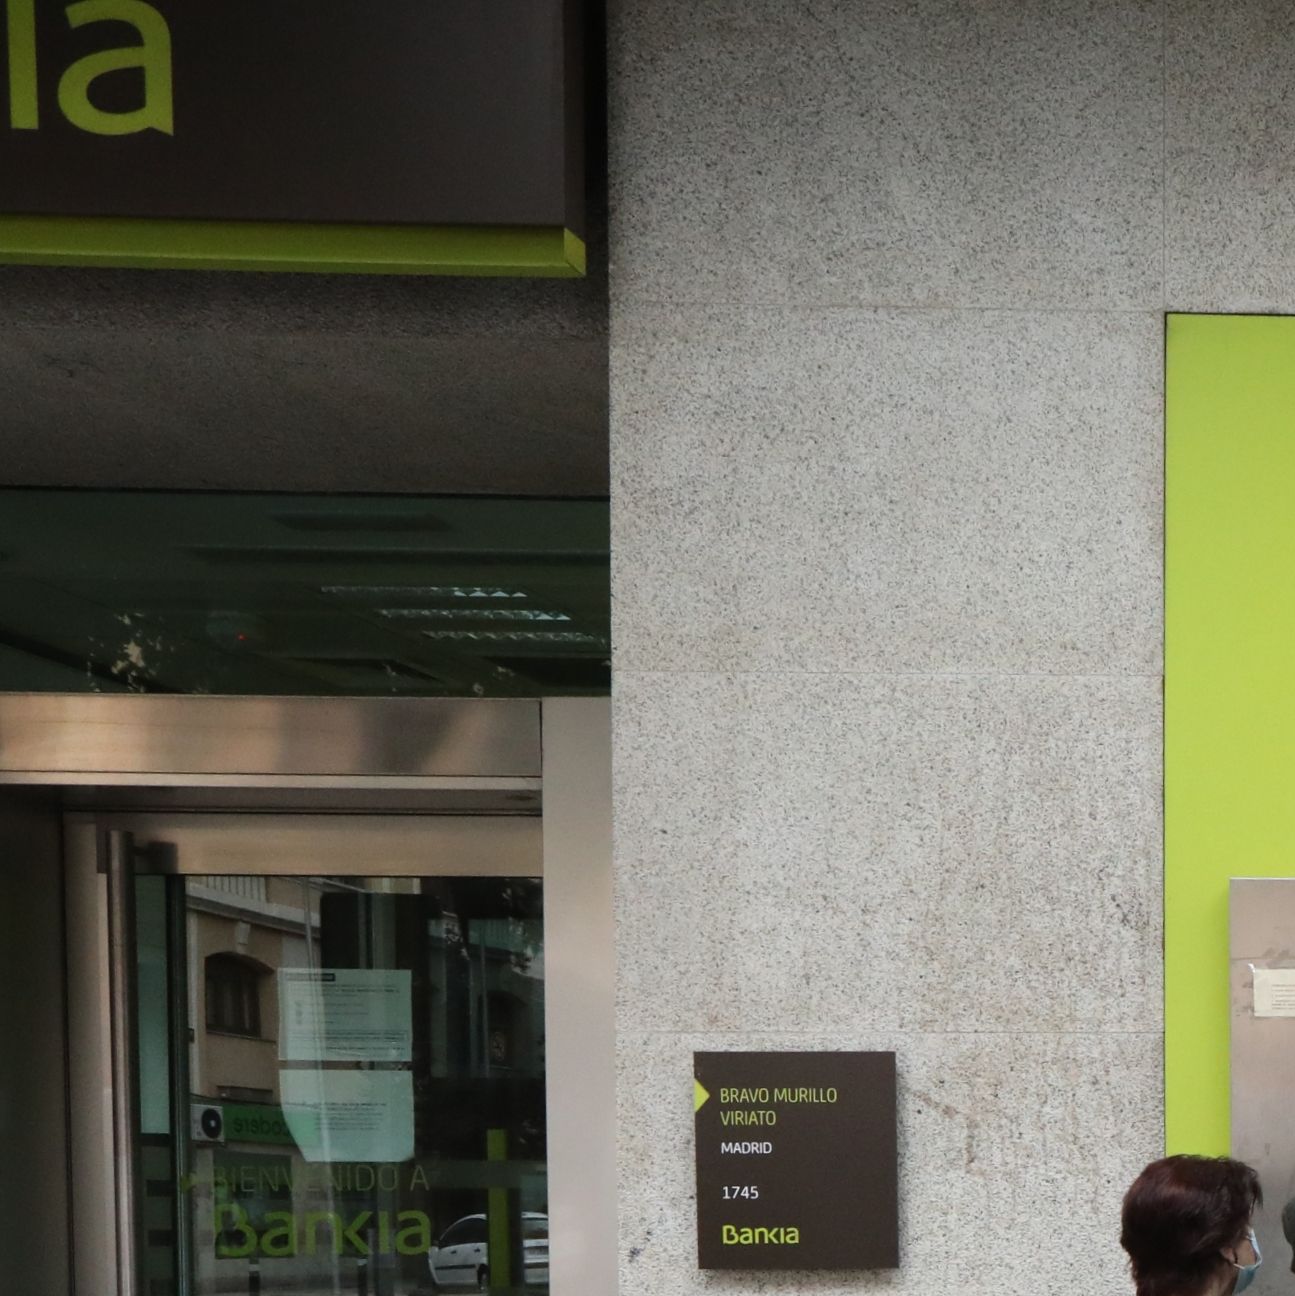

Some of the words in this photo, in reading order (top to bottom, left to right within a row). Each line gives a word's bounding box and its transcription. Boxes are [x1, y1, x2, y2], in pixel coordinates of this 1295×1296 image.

[720, 1087, 769, 1103] BRAVO
[774, 1087, 838, 1103] MURILLO
[720, 1110, 777, 1126] VIRIATO
[721, 1142, 773, 1154] MADRID
[409, 1164, 430, 1192] A
[722, 1186, 759, 1200] 1745
[214, 1203, 432, 1257] Bankia
[722, 1225, 800, 1245] Bankia
